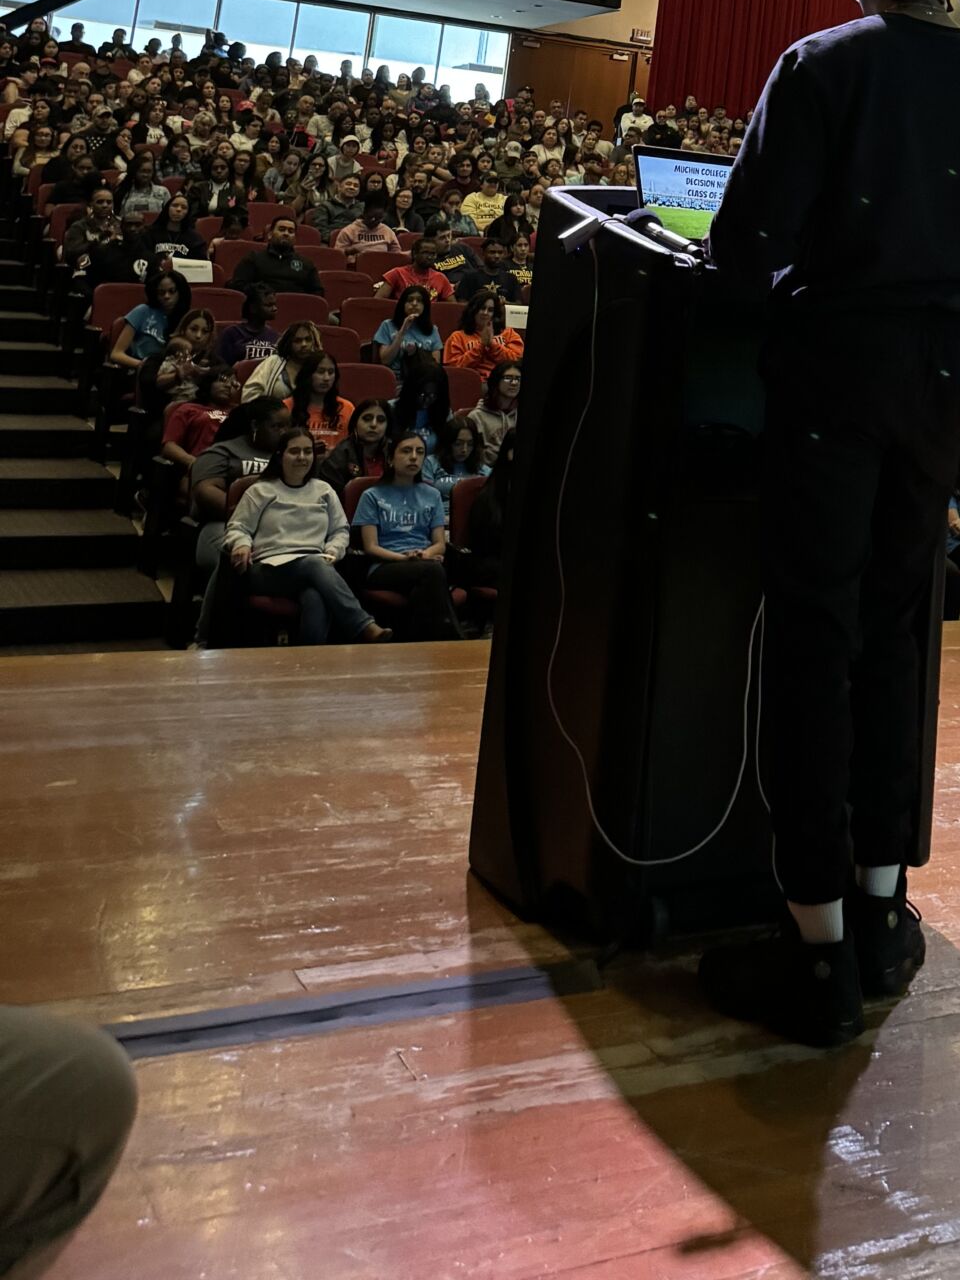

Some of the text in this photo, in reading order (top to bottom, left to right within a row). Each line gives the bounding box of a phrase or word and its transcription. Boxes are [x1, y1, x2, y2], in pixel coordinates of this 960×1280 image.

[674, 165, 728, 178] MUCHIN COLLEGE
[685, 177, 716, 189] DECISION
[687, 189, 708, 199] CLASS
[709, 191, 718, 199] OF
